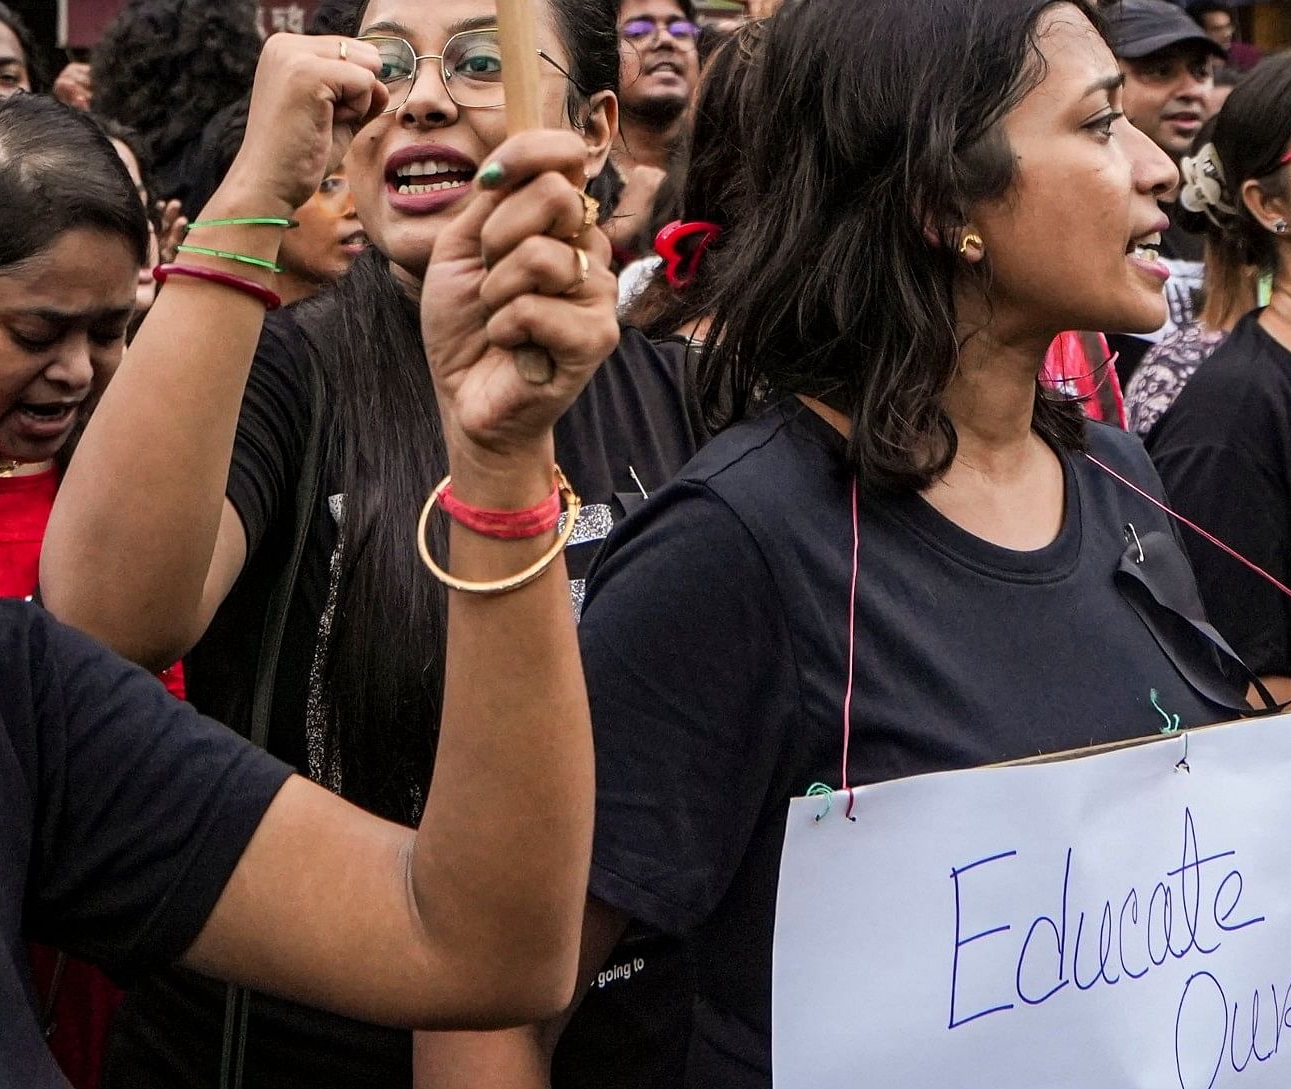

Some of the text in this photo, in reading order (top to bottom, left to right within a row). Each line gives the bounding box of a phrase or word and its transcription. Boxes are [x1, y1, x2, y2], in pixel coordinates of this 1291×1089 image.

[597, 957, 645, 988] going to
[948, 806, 1266, 1030] Educate
